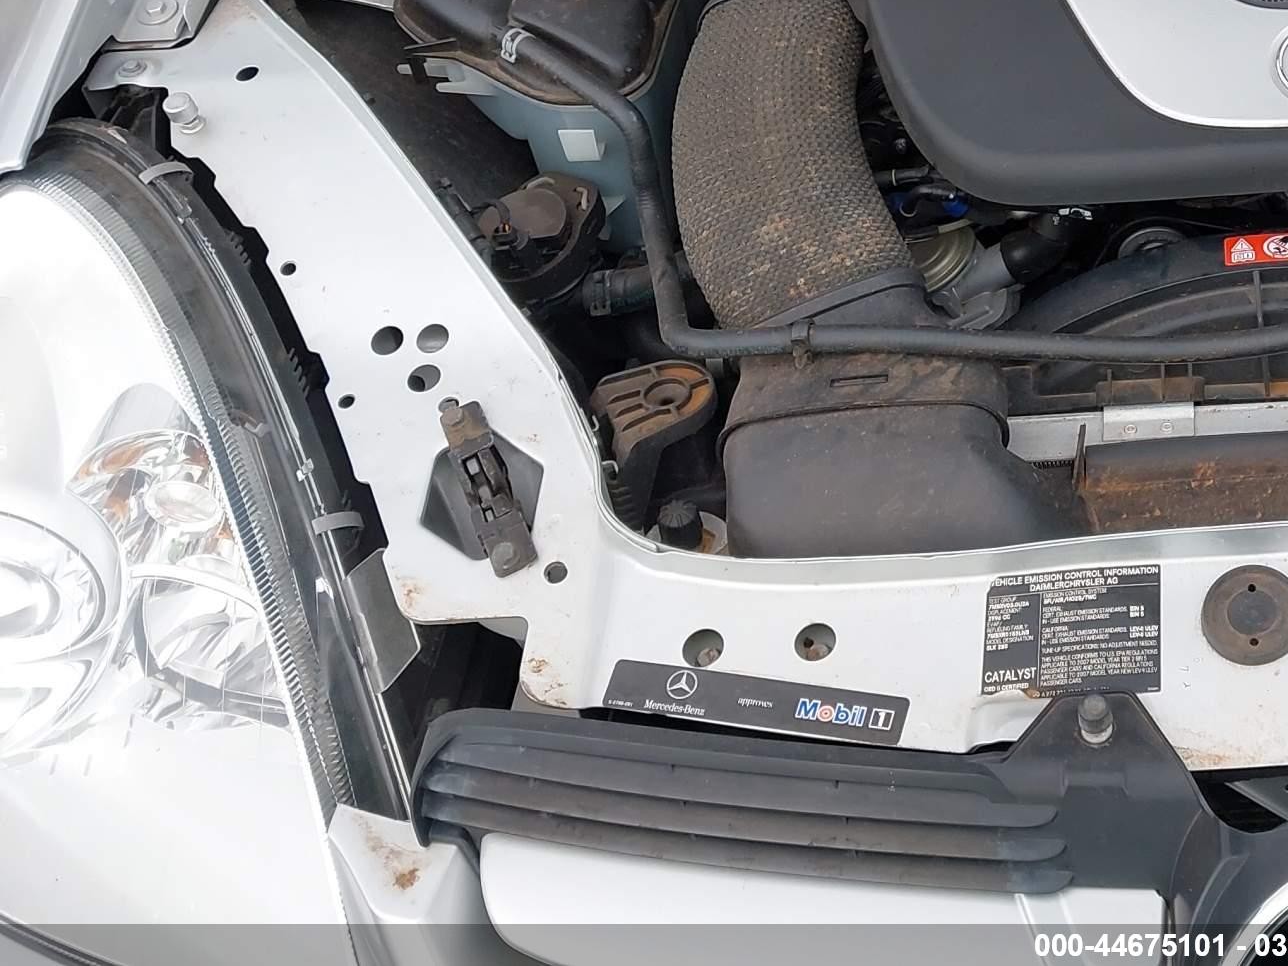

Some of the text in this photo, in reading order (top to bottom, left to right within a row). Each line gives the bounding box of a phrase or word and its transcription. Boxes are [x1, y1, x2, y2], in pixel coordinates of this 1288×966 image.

[1025, 574, 1062, 584] EMISSION
[1064, 570, 1102, 580] CONTROL
[1104, 566, 1158, 576] INFORMATION
[1030, 578, 1104, 592] DAIMLERCHRYSLER
[984, 667, 1036, 683] CATALYST
[1001, 682, 1029, 691] CERTIFIED
[644, 699, 705, 716] Mercedes-Benz
[737, 696, 773, 709] approves
[794, 698, 868, 726] Mobil
